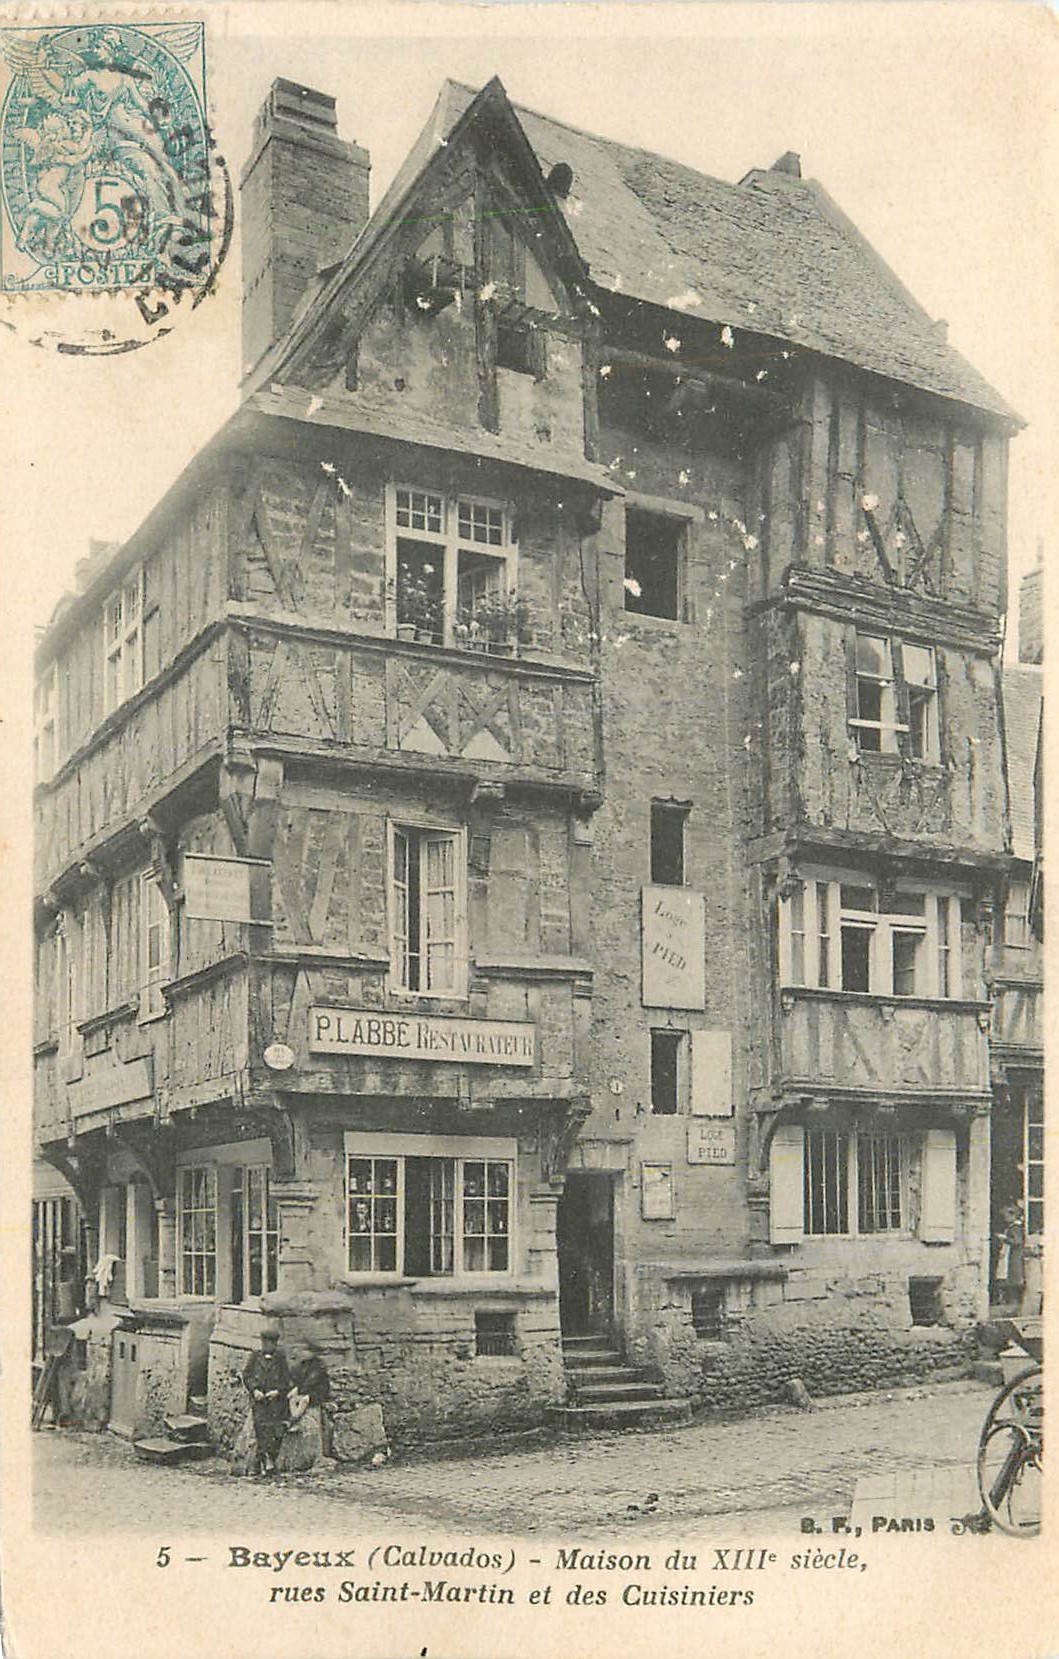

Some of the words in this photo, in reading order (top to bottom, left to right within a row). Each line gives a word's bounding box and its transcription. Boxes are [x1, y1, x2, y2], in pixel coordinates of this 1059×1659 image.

[90, 181, 127, 245] 5
[63, 264, 152, 287] POSTES
[652, 943, 687, 970] PIED
